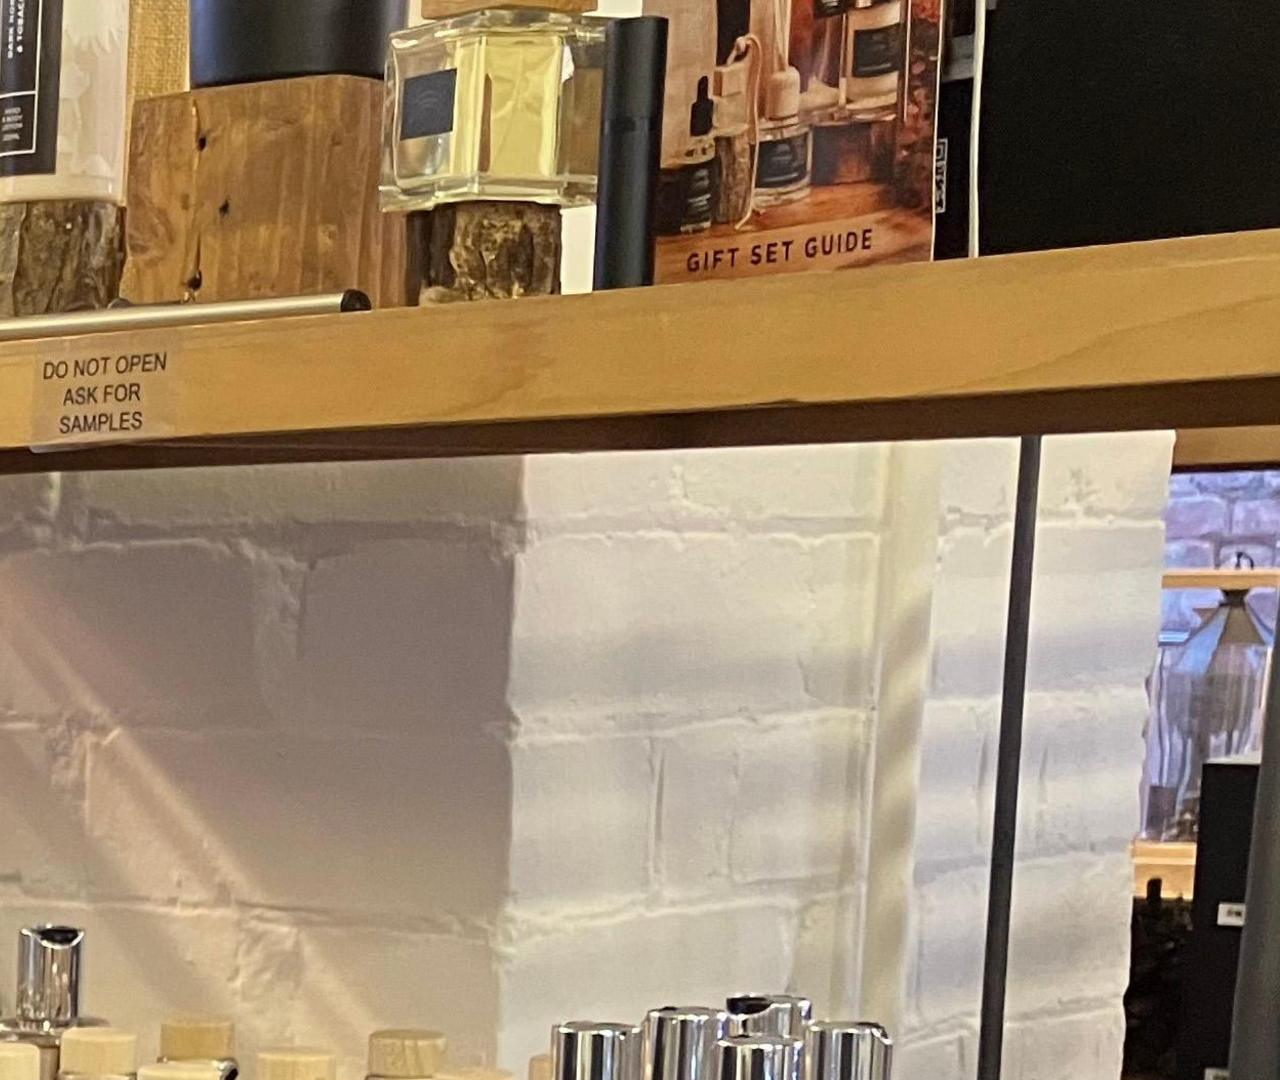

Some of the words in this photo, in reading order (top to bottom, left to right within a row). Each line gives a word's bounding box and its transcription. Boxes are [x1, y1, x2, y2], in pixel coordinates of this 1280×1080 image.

[687, 248, 739, 272] GIFT
[750, 240, 794, 265] SET
[804, 229, 872, 258] GUIDE
[43, 361, 69, 379] DO
[74, 357, 111, 378] NOT
[115, 352, 167, 374] OPEN
[63, 386, 98, 406] ASK
[103, 383, 141, 403] FOR
[59, 411, 143, 434] SAMPLES
